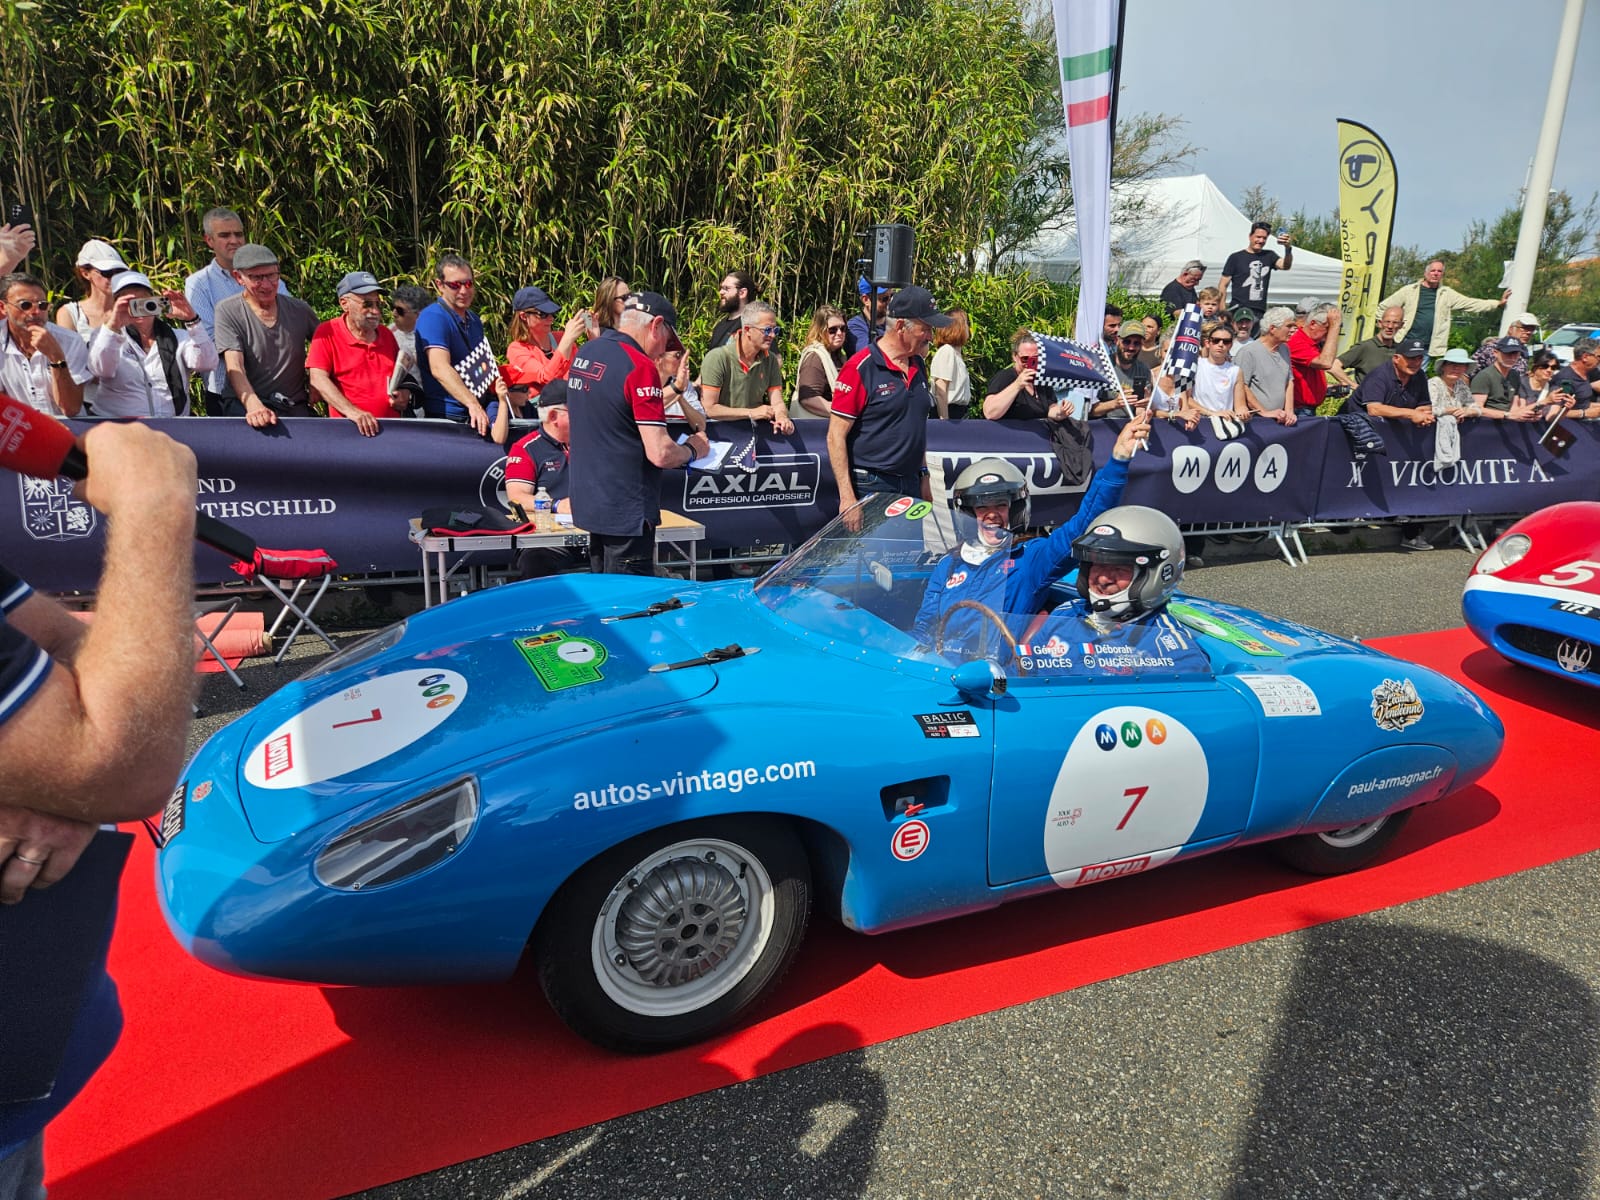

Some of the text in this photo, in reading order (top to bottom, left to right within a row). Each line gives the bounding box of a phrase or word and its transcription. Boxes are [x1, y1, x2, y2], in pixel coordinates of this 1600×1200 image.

[1178, 342, 1198, 354] AUTO
[689, 471, 811, 495] AXIAL
[1389, 458, 1520, 487] VICOMTE
[199, 498, 337, 519] THSCHILD
[689, 492, 811, 505] PROFESSION CARROSSIER
[1095, 644, 1133, 654] Déborah
[921, 712, 966, 723] BALTIC
[269, 737, 288, 777] MOTUL
[573, 760, 816, 811] autos-vintage.com
[1347, 765, 1443, 799] paul-armagnac.fr
[1116, 785, 1149, 831] 7
[901, 828, 921, 848] E
[1080, 860, 1143, 882] MOTUL
